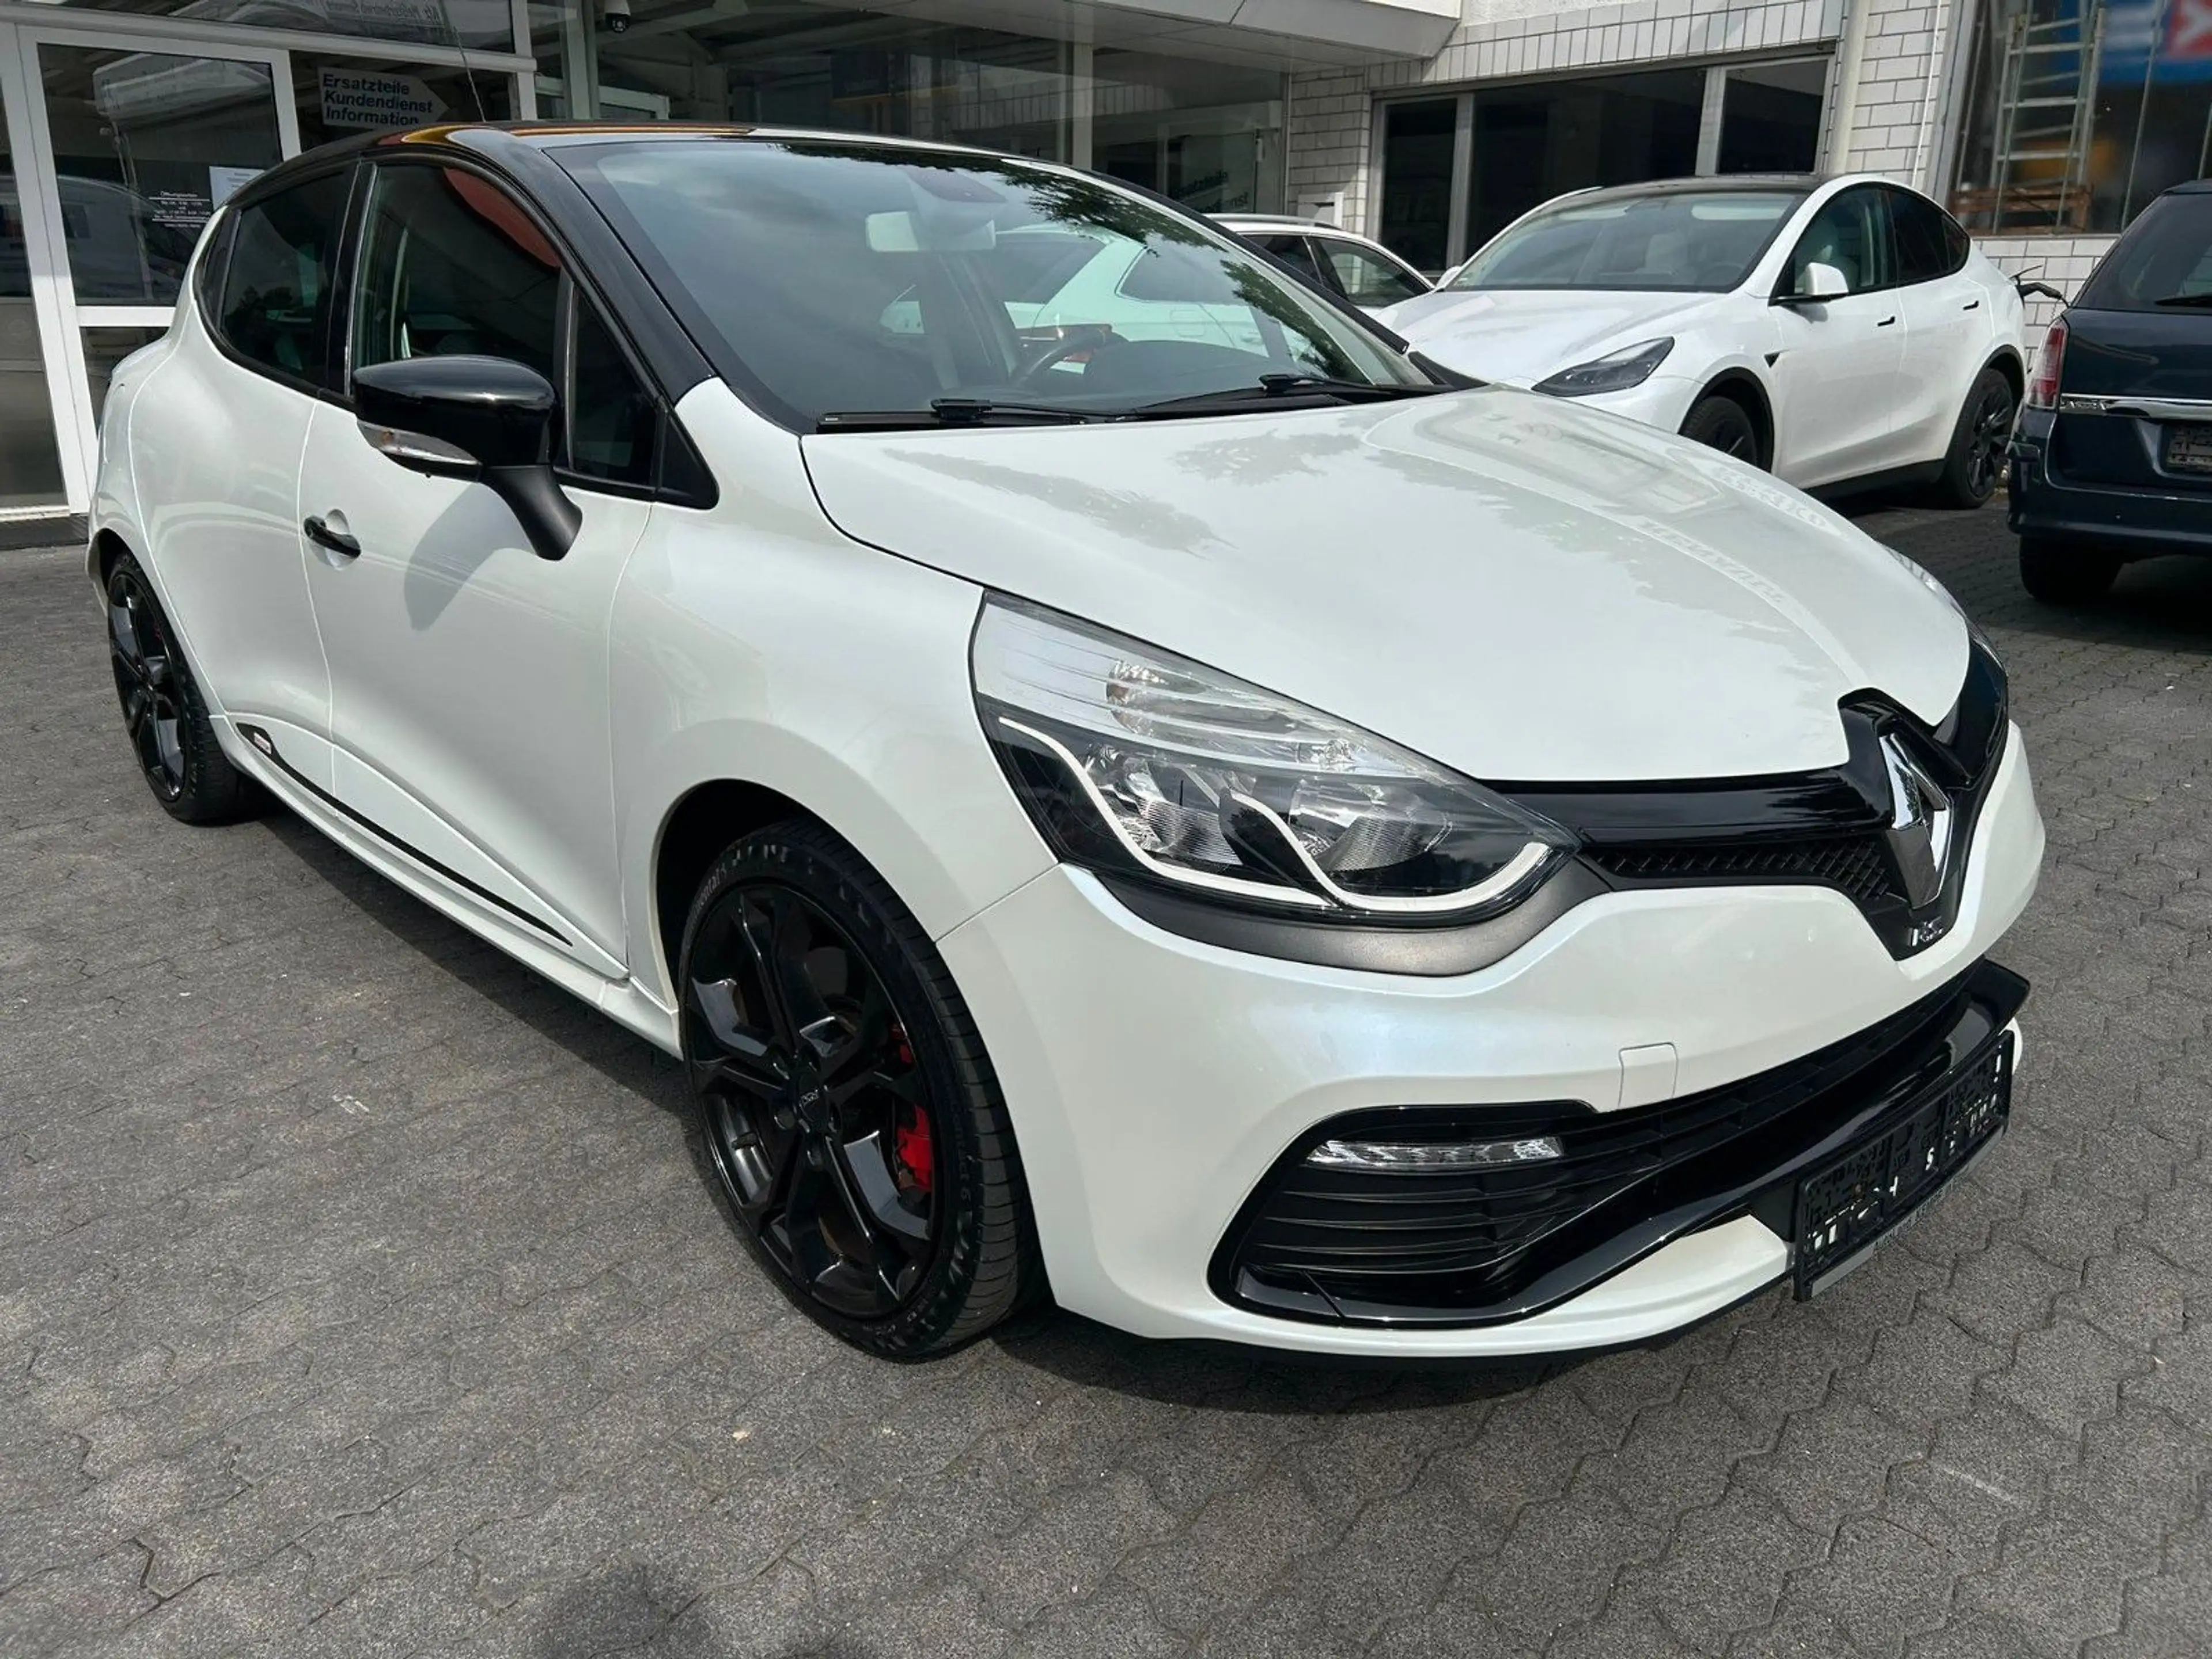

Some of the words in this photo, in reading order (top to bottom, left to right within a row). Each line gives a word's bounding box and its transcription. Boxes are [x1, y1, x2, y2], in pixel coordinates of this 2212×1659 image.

[323, 73, 410, 95] Ersatzteile
[324, 90, 432, 113] Kundendienst
[326, 106, 419, 126] Information
